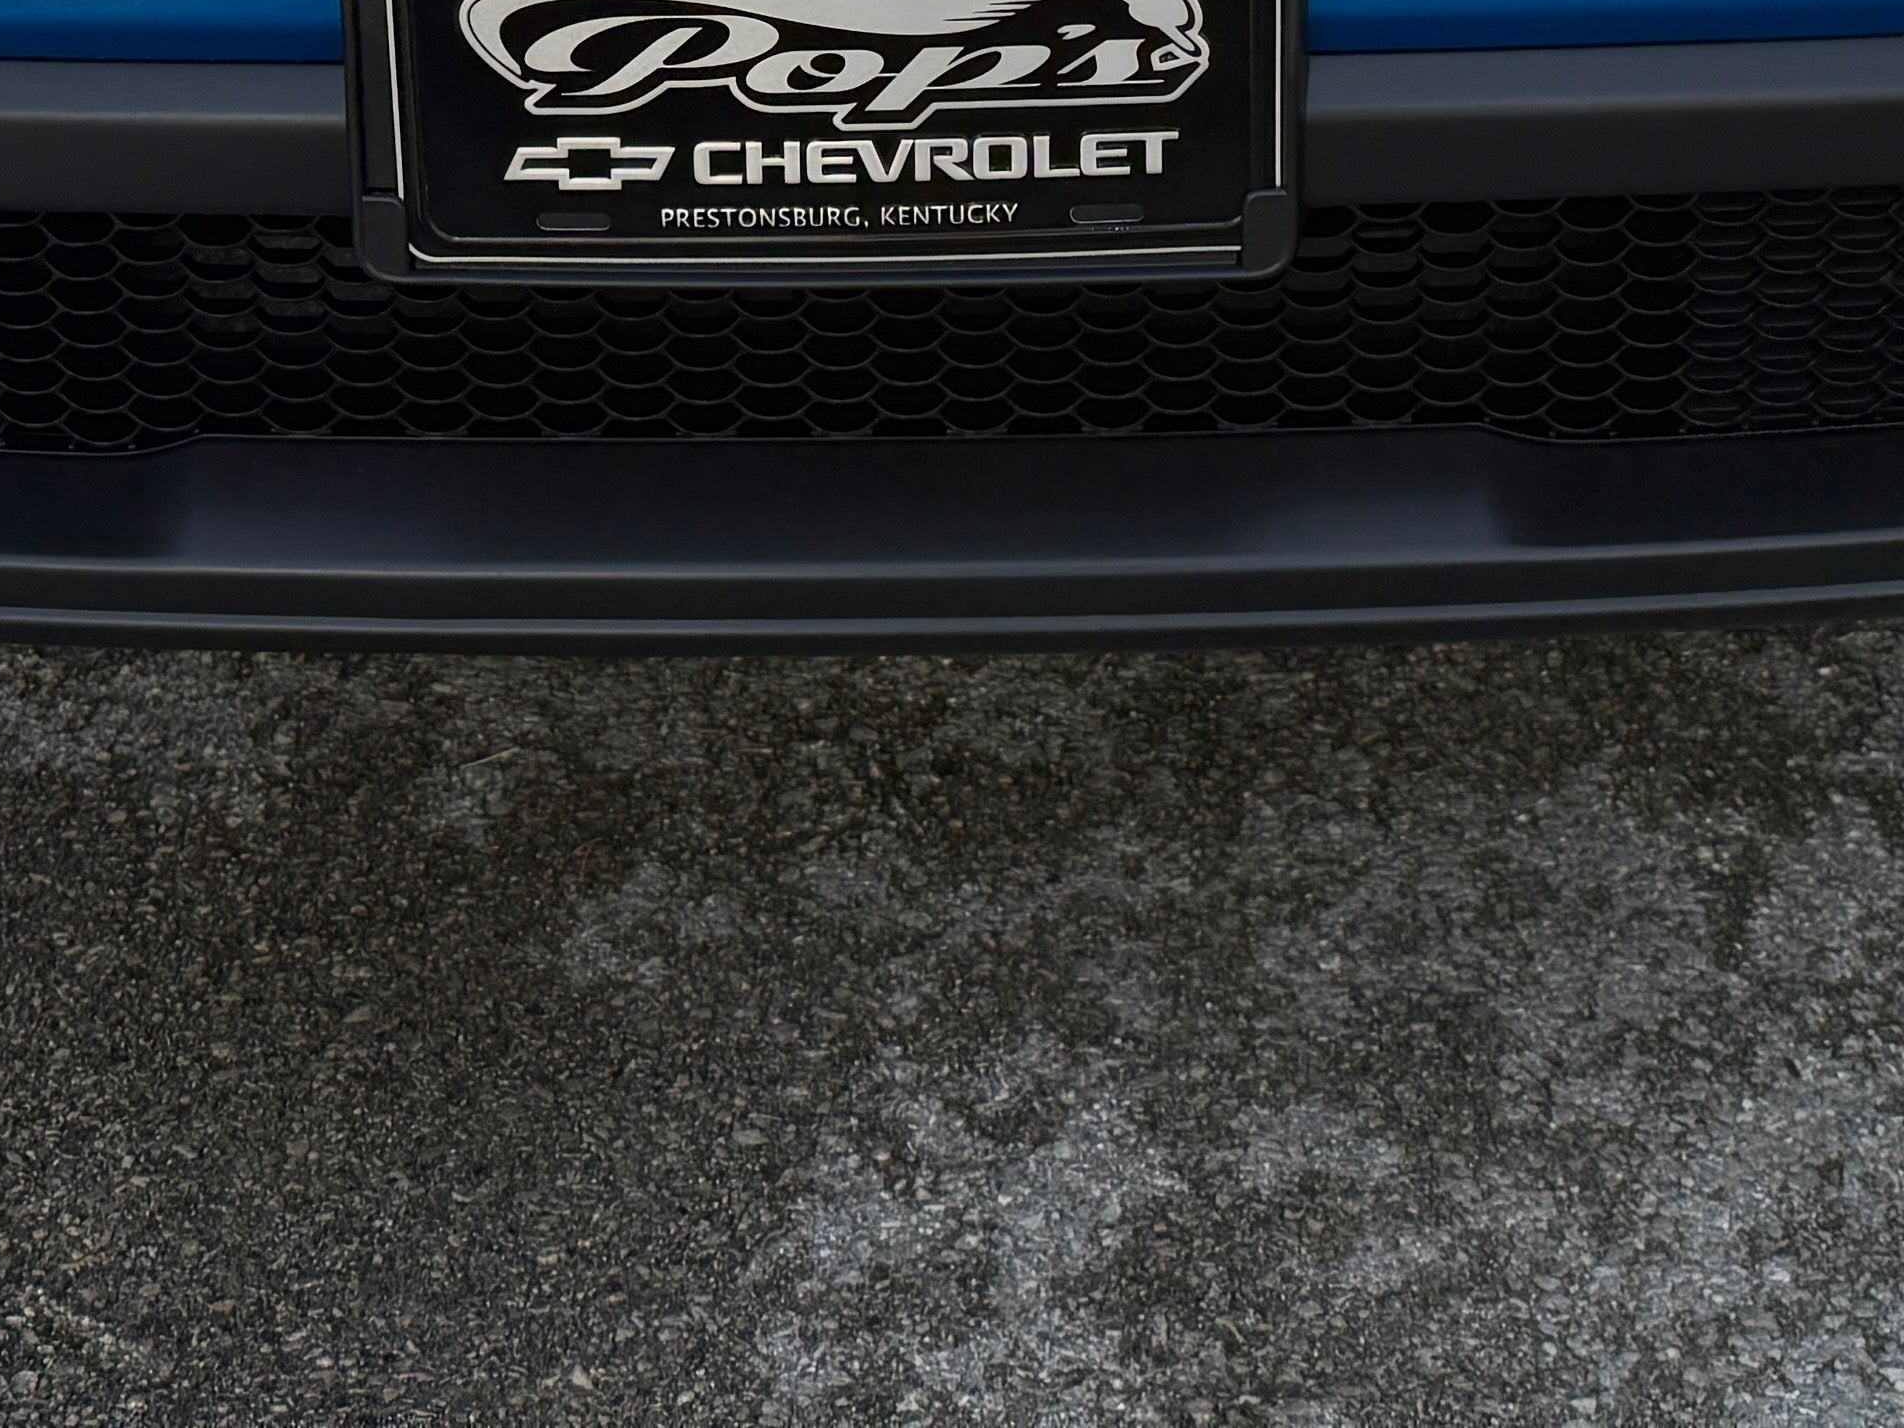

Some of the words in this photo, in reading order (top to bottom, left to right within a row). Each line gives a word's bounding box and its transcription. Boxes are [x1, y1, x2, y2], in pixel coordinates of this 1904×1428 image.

[524, 13, 1165, 112] Pop's
[694, 128, 1179, 186] CHEVROLET
[660, 205, 869, 230] PRESTONSBURG,
[880, 202, 1018, 226] KENTUCKY
